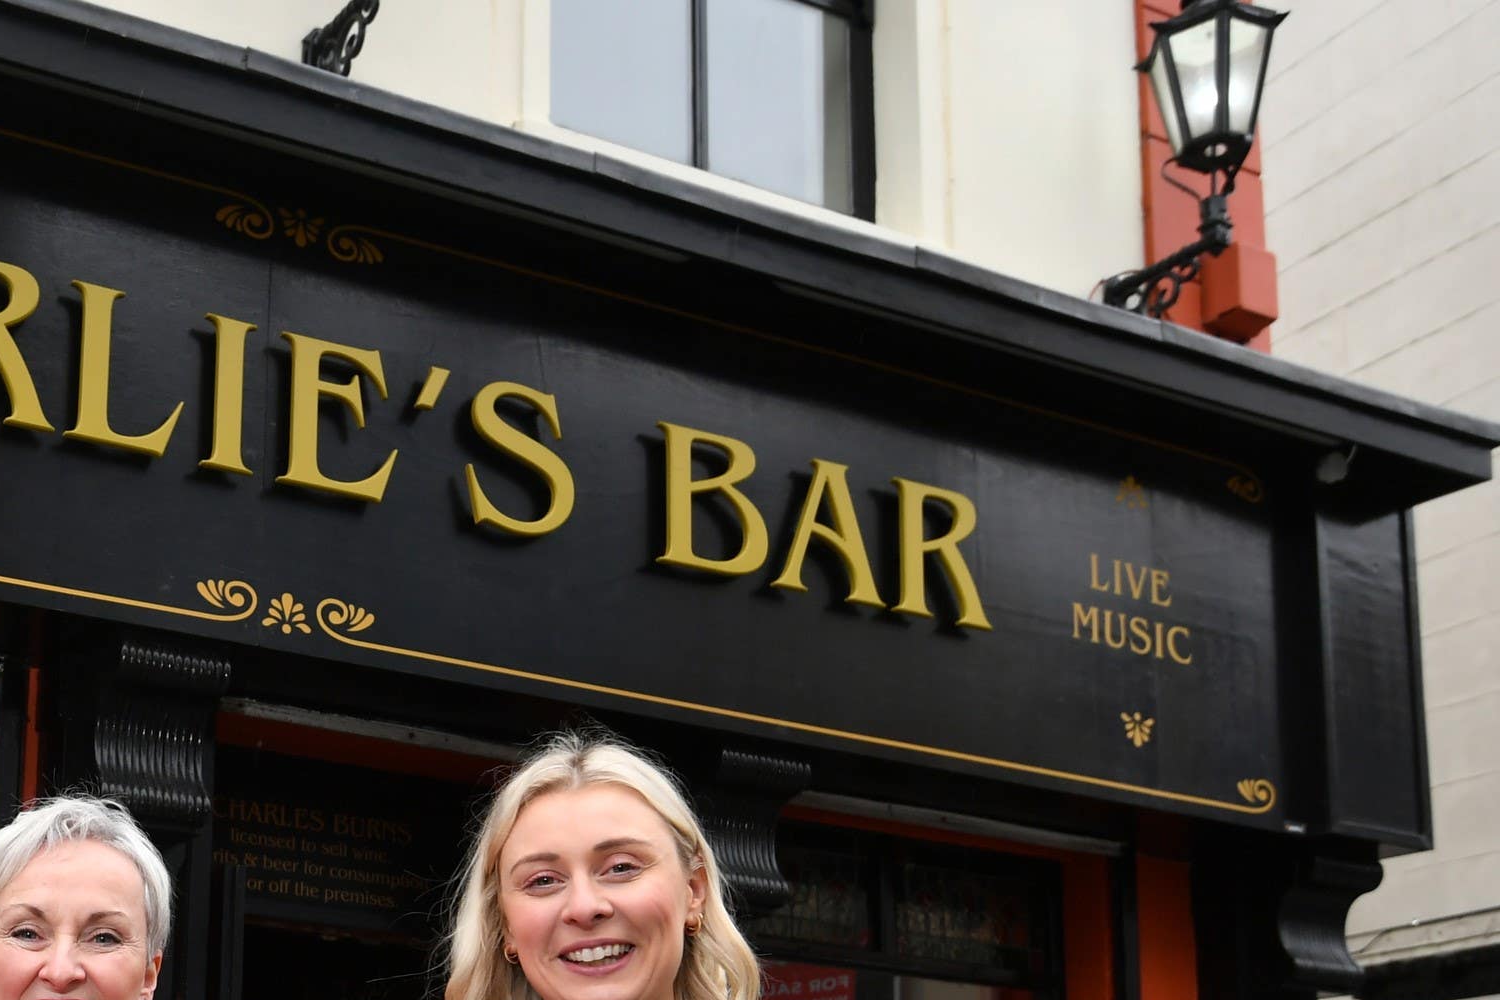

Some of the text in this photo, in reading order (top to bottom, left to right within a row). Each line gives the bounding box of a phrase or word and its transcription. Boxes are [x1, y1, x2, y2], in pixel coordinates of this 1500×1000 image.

[656, 420, 994, 630] BAR
[1090, 553, 1173, 608] LIVE
[1072, 602, 1193, 665] MUSIC
[212, 797, 412, 845] CHARLES BURNS
[230, 827, 296, 851] licensed
[301, 834, 318, 853] to
[321, 839, 348, 858] sell
[243, 850, 259, 868] &
[262, 853, 299, 873] beer
[304, 857, 324, 877] for
[246, 877, 263, 892] or
[269, 876, 291, 895] off
[295, 880, 319, 898] the
